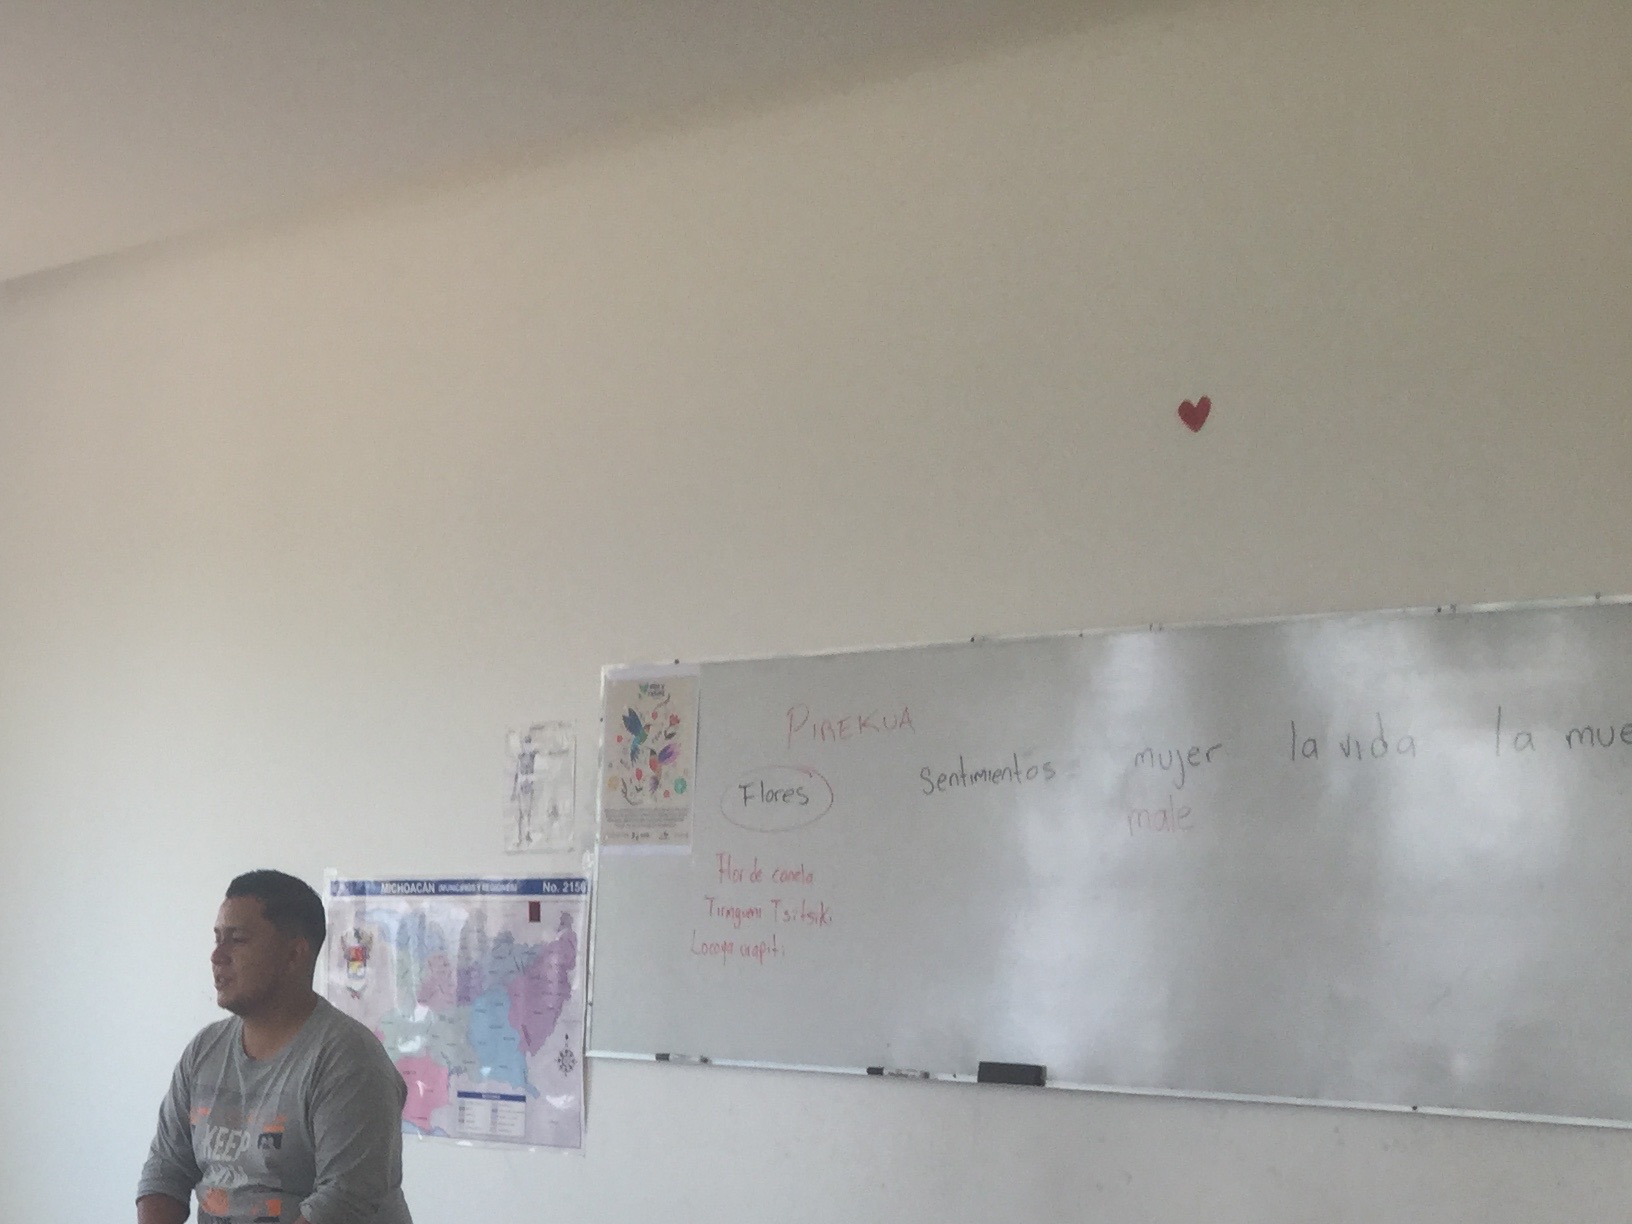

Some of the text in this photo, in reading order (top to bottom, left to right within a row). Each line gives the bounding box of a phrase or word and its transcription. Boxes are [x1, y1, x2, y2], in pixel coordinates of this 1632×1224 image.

[1289, 711, 1417, 761] la vida
[1496, 705, 1536, 757] la
[919, 752, 1058, 797] Sentimientos
[1134, 742, 1223, 790] mujer
[737, 781, 811, 807] Flores
[380, 880, 436, 894] MICHOACÁN
[542, 880, 559, 893] No.
[749, 855, 763, 884] de
[202, 1124, 251, 1162] KEEP
